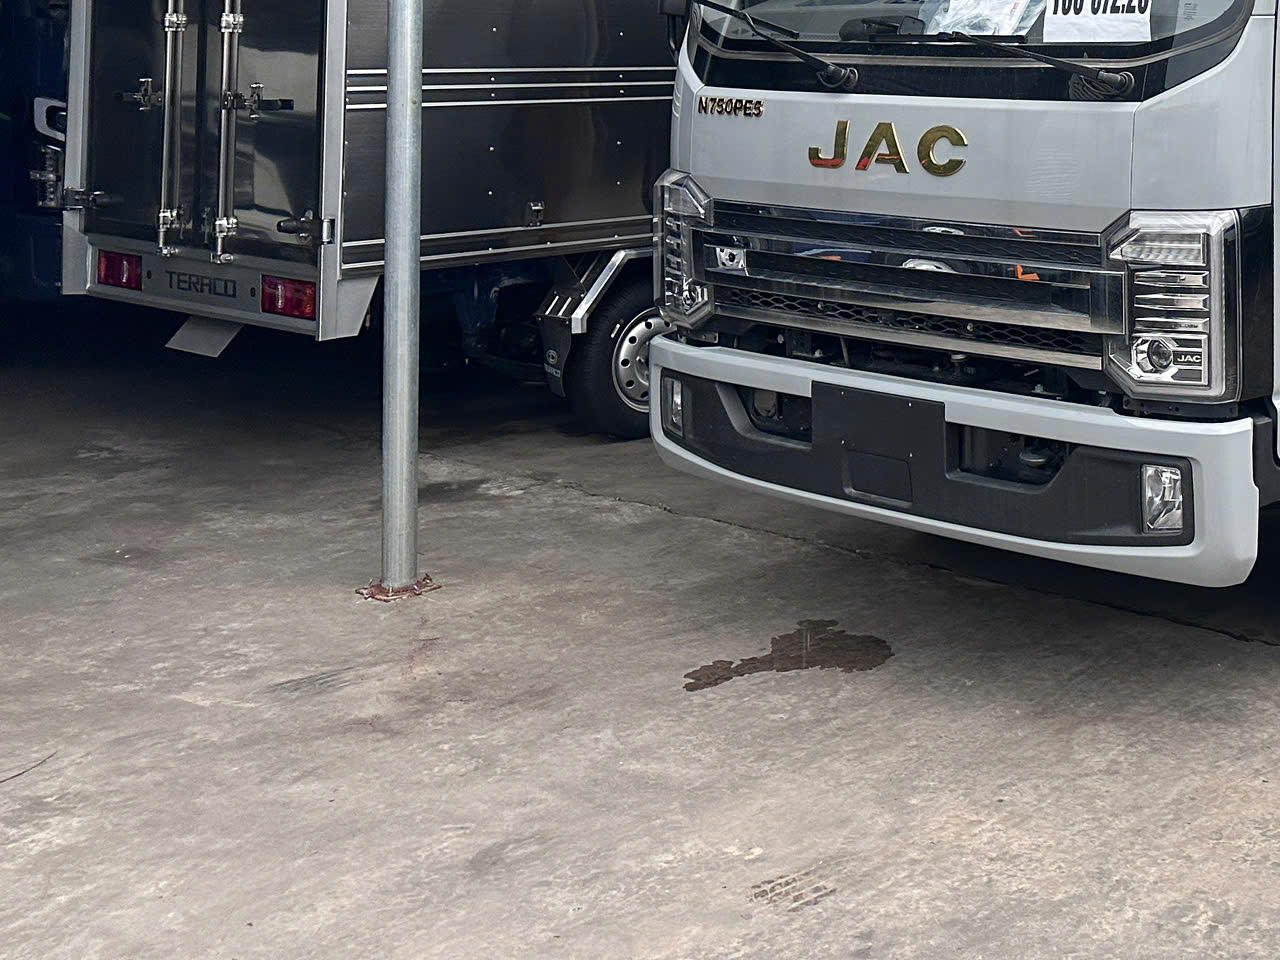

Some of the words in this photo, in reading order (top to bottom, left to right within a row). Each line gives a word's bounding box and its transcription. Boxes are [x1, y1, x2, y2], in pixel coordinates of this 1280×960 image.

[808, 119, 969, 177] JAC
[165, 270, 237, 298] TERACO
[1176, 354, 1202, 363] JAC
